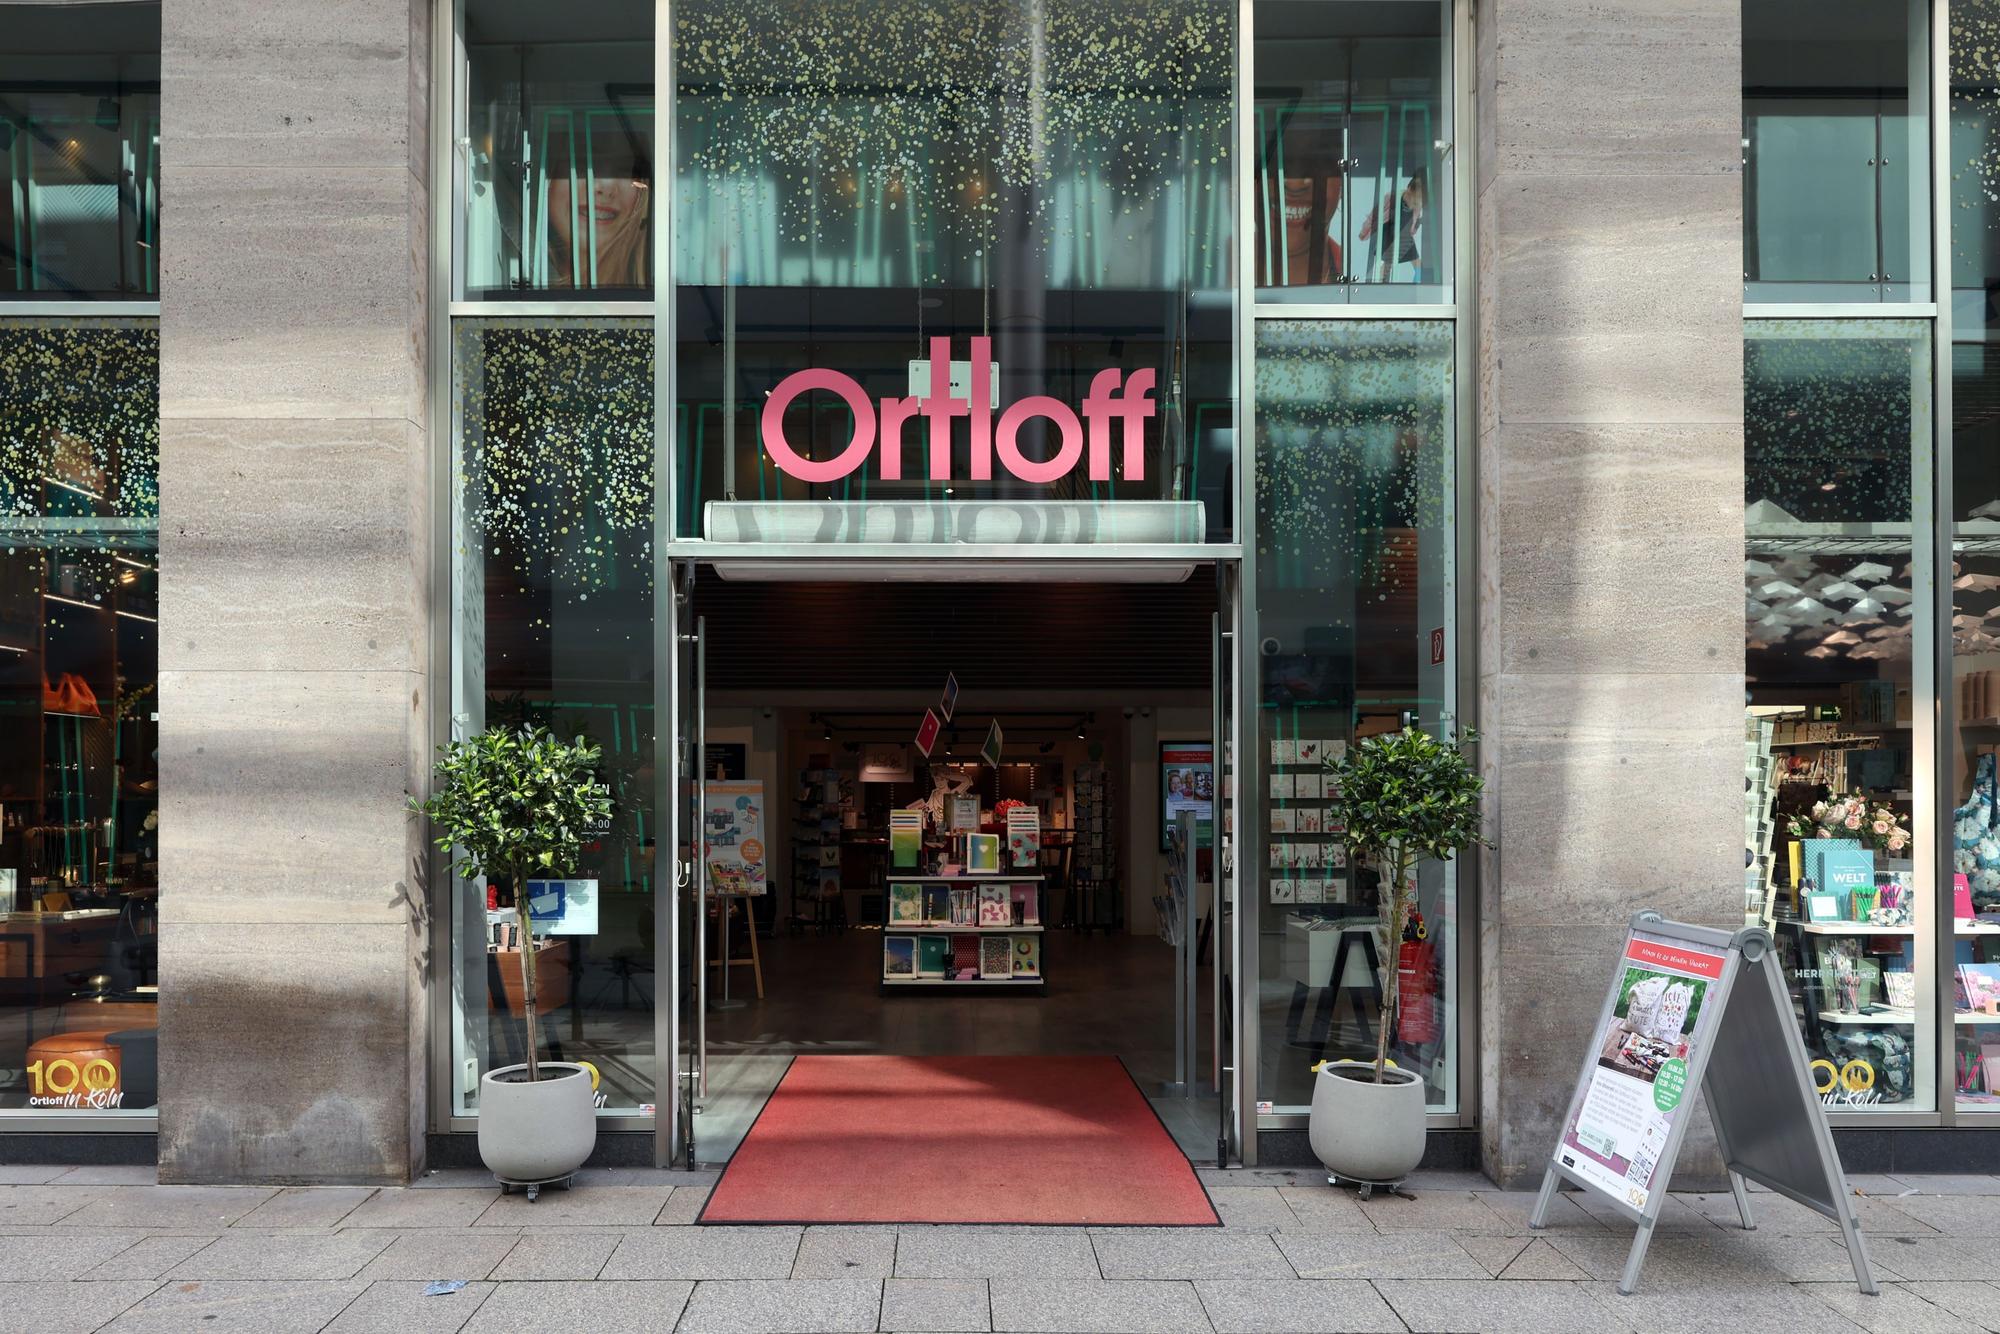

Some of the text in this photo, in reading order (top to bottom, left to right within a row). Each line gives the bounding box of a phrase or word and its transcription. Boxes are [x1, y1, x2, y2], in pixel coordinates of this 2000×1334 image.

[761, 336, 1156, 483] Ortloff
[1832, 872, 1867, 883] WELT
[26, 1059, 117, 1095] 100
[29, 1087, 124, 1110] Ortloff in Köln
